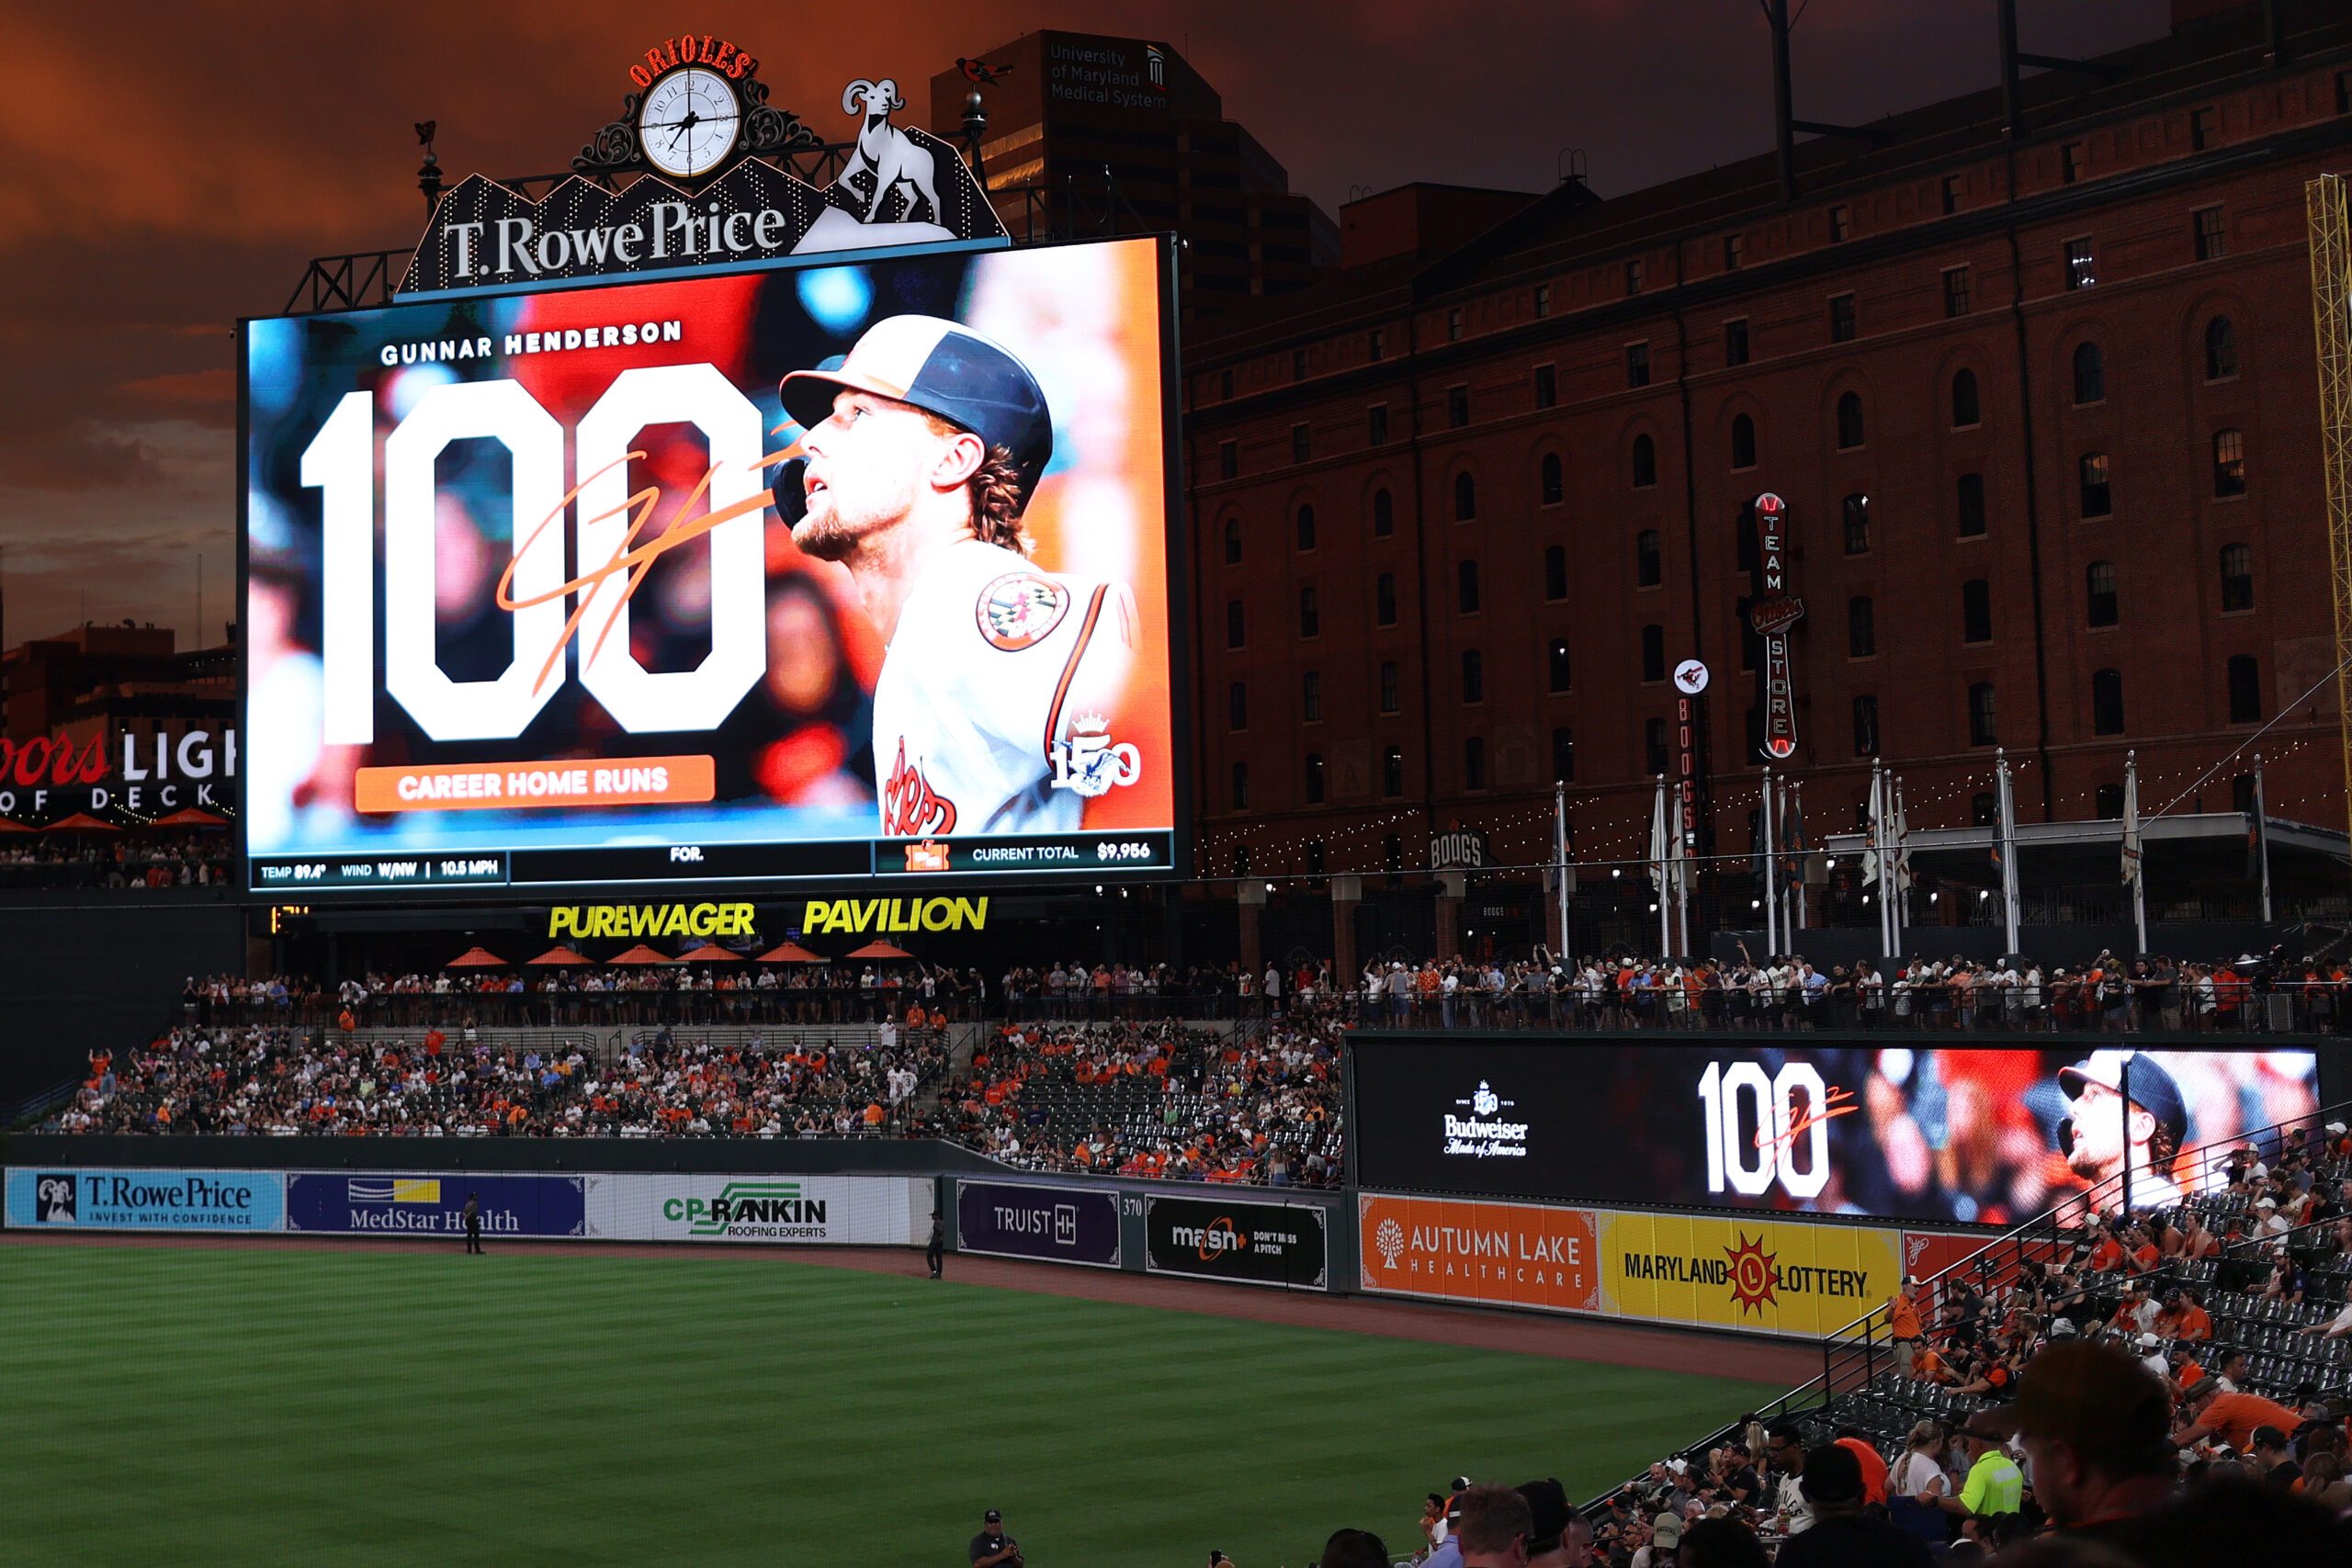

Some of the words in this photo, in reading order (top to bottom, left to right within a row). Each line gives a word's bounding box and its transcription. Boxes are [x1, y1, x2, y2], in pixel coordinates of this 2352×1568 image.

[629, 34, 751, 88] ORIOLES
[1051, 44, 1125, 68] University
[1052, 64, 1068, 79] of
[1071, 66, 1140, 86] Maryland
[1052, 84, 1109, 104] Medical
[1114, 90, 1166, 108] System
[380, 337, 492, 366] GUNNAR
[504, 320, 682, 355] HENDERSON
[300, 363, 767, 745] 100
[1763, 515, 1781, 590] TEAM
[1771, 640, 1787, 734] STORE
[398, 772, 503, 801] CAREER
[507, 769, 589, 797] HOME
[594, 766, 669, 794] RUNS
[92, 784, 212, 809] DECK
[670, 847, 705, 863] FOR.
[972, 847, 1033, 862] CURRENT
[1035, 846, 1080, 860] TOTAL
[1097, 842, 1151, 862] $9,956
[261, 866, 292, 878] TEMP
[341, 864, 372, 877] WIND
[440, 861, 467, 875] 10.5
[468, 859, 498, 874] MPH
[548, 902, 756, 938] PUREWAGER
[803, 897, 989, 934] PAVILION
[1443, 1114, 1529, 1140] Budweiser
[1698, 1061, 1830, 1198] 100
[1443, 1137, 1476, 1155] Made
[1476, 1140, 1487, 1159] of
[1485, 1140, 1527, 1156] America
[90, 1213, 133, 1223] INVEST
[139, 1213, 169, 1224] WITH
[173, 1213, 252, 1224] CONFIDENCE
[350, 1208, 439, 1230] MedStar
[994, 1206, 1051, 1235] TRUIST
[1123, 1199, 1143, 1218] 370
[728, 1226, 777, 1236] ROOFING
[779, 1227, 827, 1237] EXPERTS
[1261, 1244, 1283, 1255] PITCH
[1410, 1224, 1510, 1258] AUTUMN
[1520, 1233, 1580, 1266] LAKE
[1411, 1258, 1581, 1289] HEALTHCARE
[1624, 1252, 1728, 1286] MARYLAND
[1777, 1265, 1868, 1299] LOTTERY
